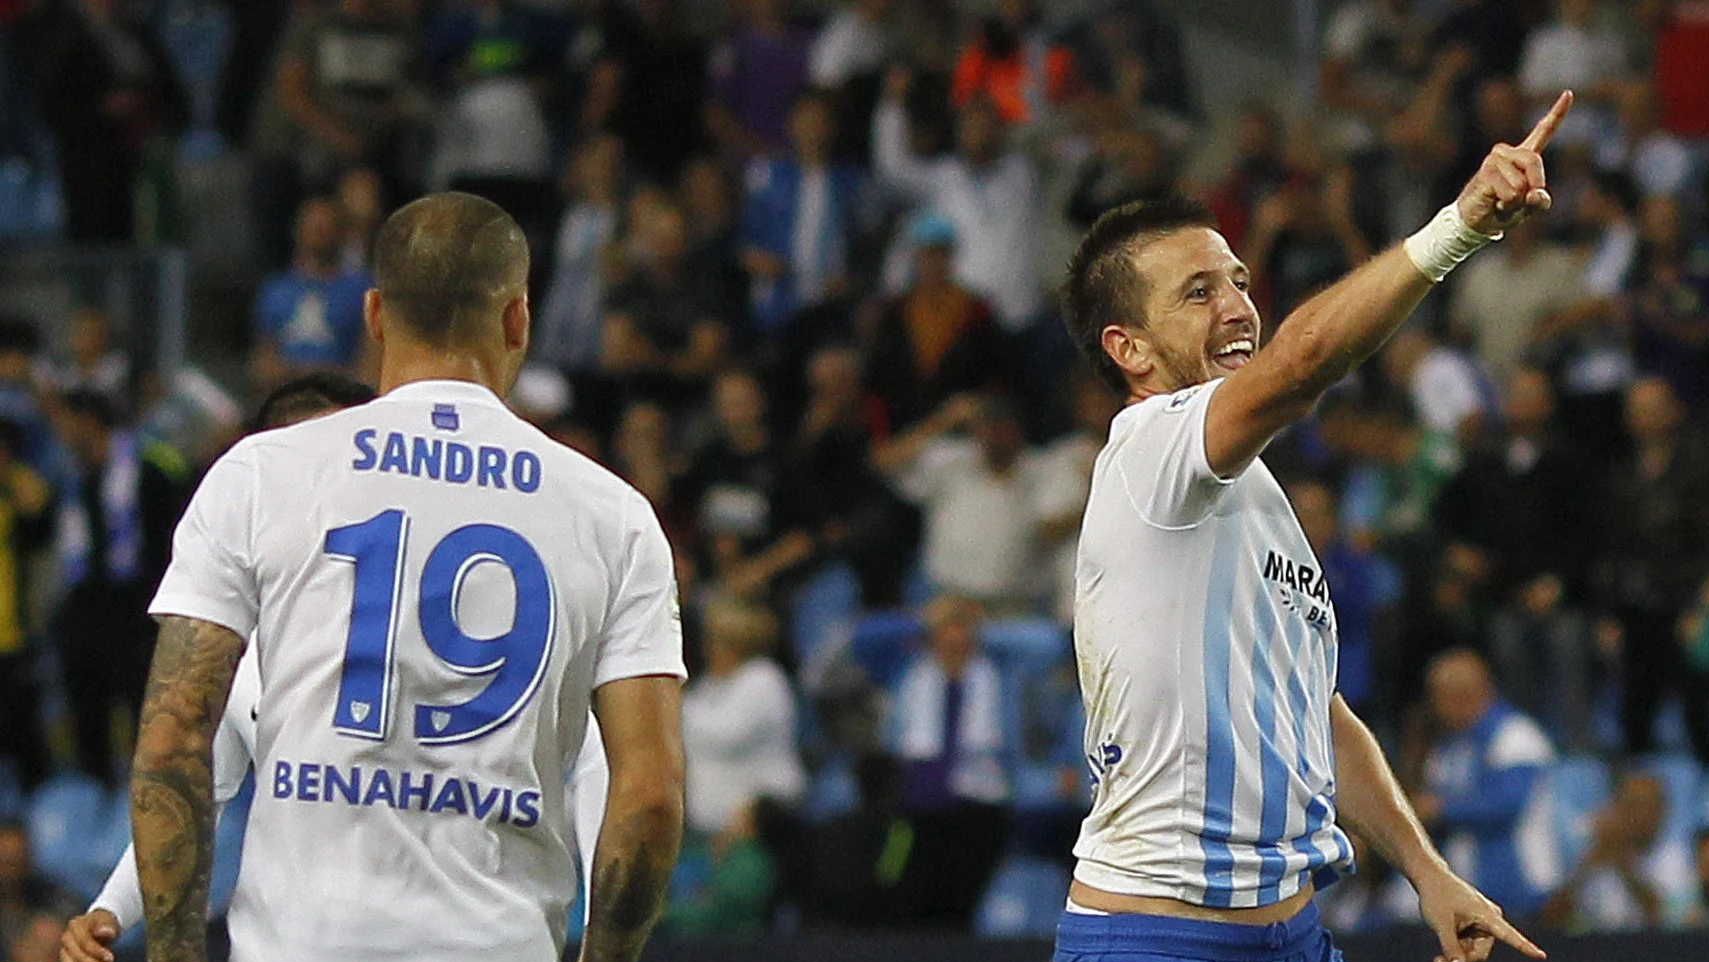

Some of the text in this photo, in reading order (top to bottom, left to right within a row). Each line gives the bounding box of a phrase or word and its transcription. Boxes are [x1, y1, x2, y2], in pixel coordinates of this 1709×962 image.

[352, 428, 542, 494] SANDRO
[1263, 549, 1331, 607] MARA
[322, 507, 557, 747] 19
[1306, 605, 1332, 632] BE
[272, 759, 542, 829] BENAHAVIS
